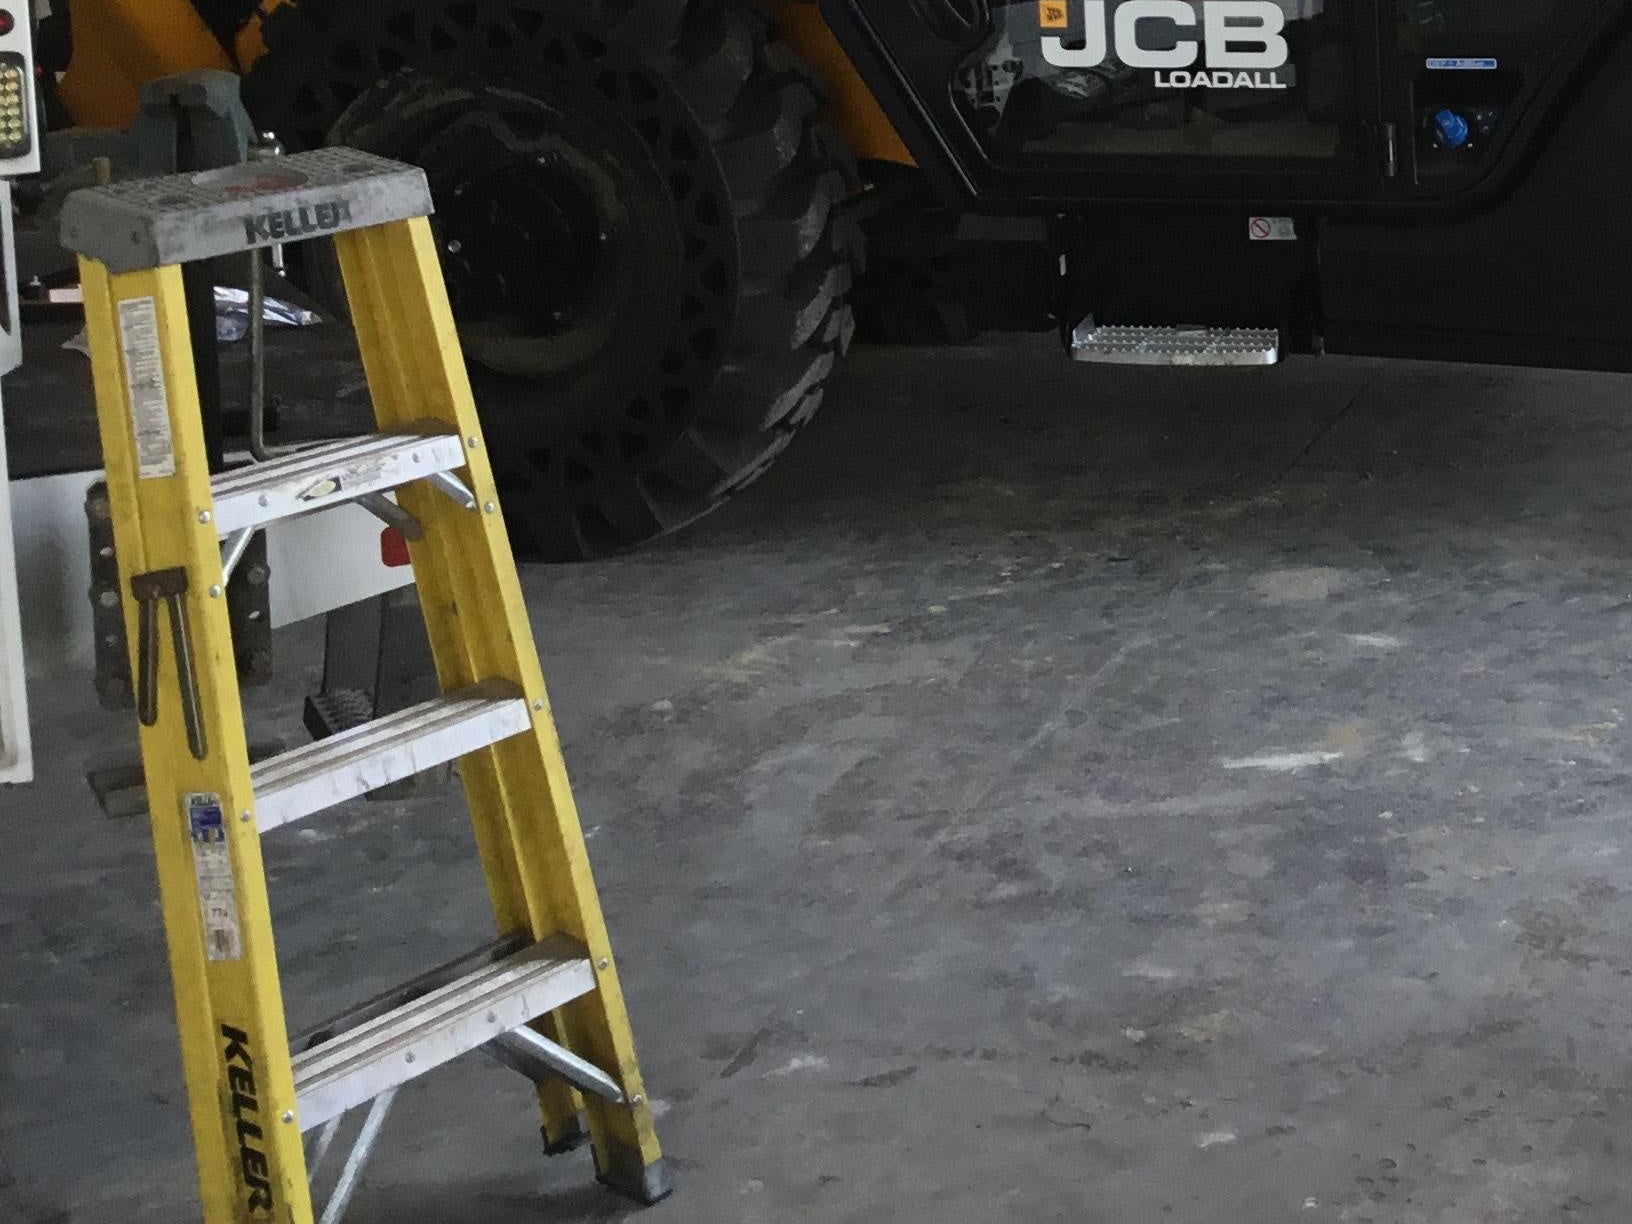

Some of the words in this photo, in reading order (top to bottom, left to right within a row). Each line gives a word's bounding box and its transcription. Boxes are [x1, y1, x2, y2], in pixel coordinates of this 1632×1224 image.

[1041, 0, 1288, 68] JCB
[1154, 71, 1287, 88] LOADALL
[221, 1023, 274, 1213] KELLER
